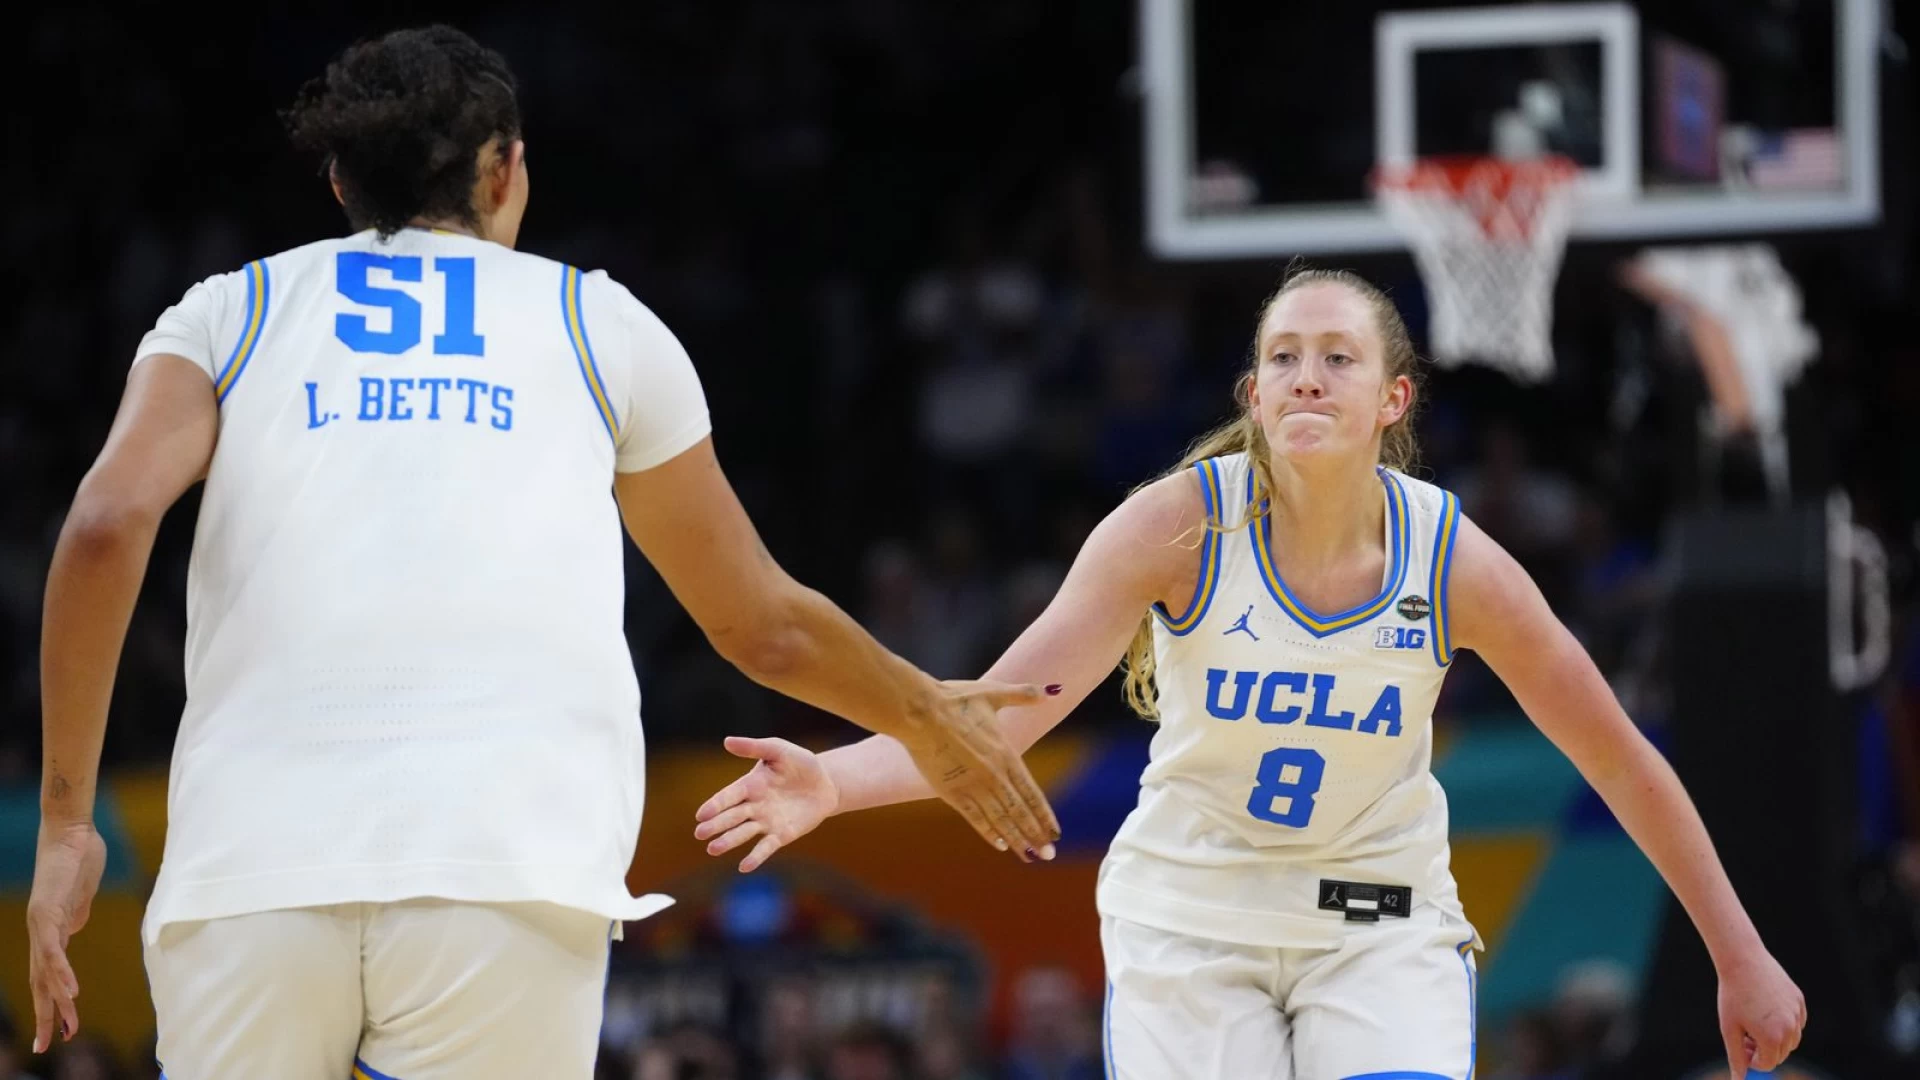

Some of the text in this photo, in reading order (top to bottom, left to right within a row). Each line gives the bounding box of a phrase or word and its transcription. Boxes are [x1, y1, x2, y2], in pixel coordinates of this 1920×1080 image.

[335, 251, 485, 357] 51
[305, 377, 514, 432] L. BETTS
[1399, 603, 1413, 611] FINAL
[1205, 667, 1403, 737] UCLA
[1246, 746, 1326, 829] 8
[1384, 893, 1398, 907] 42
